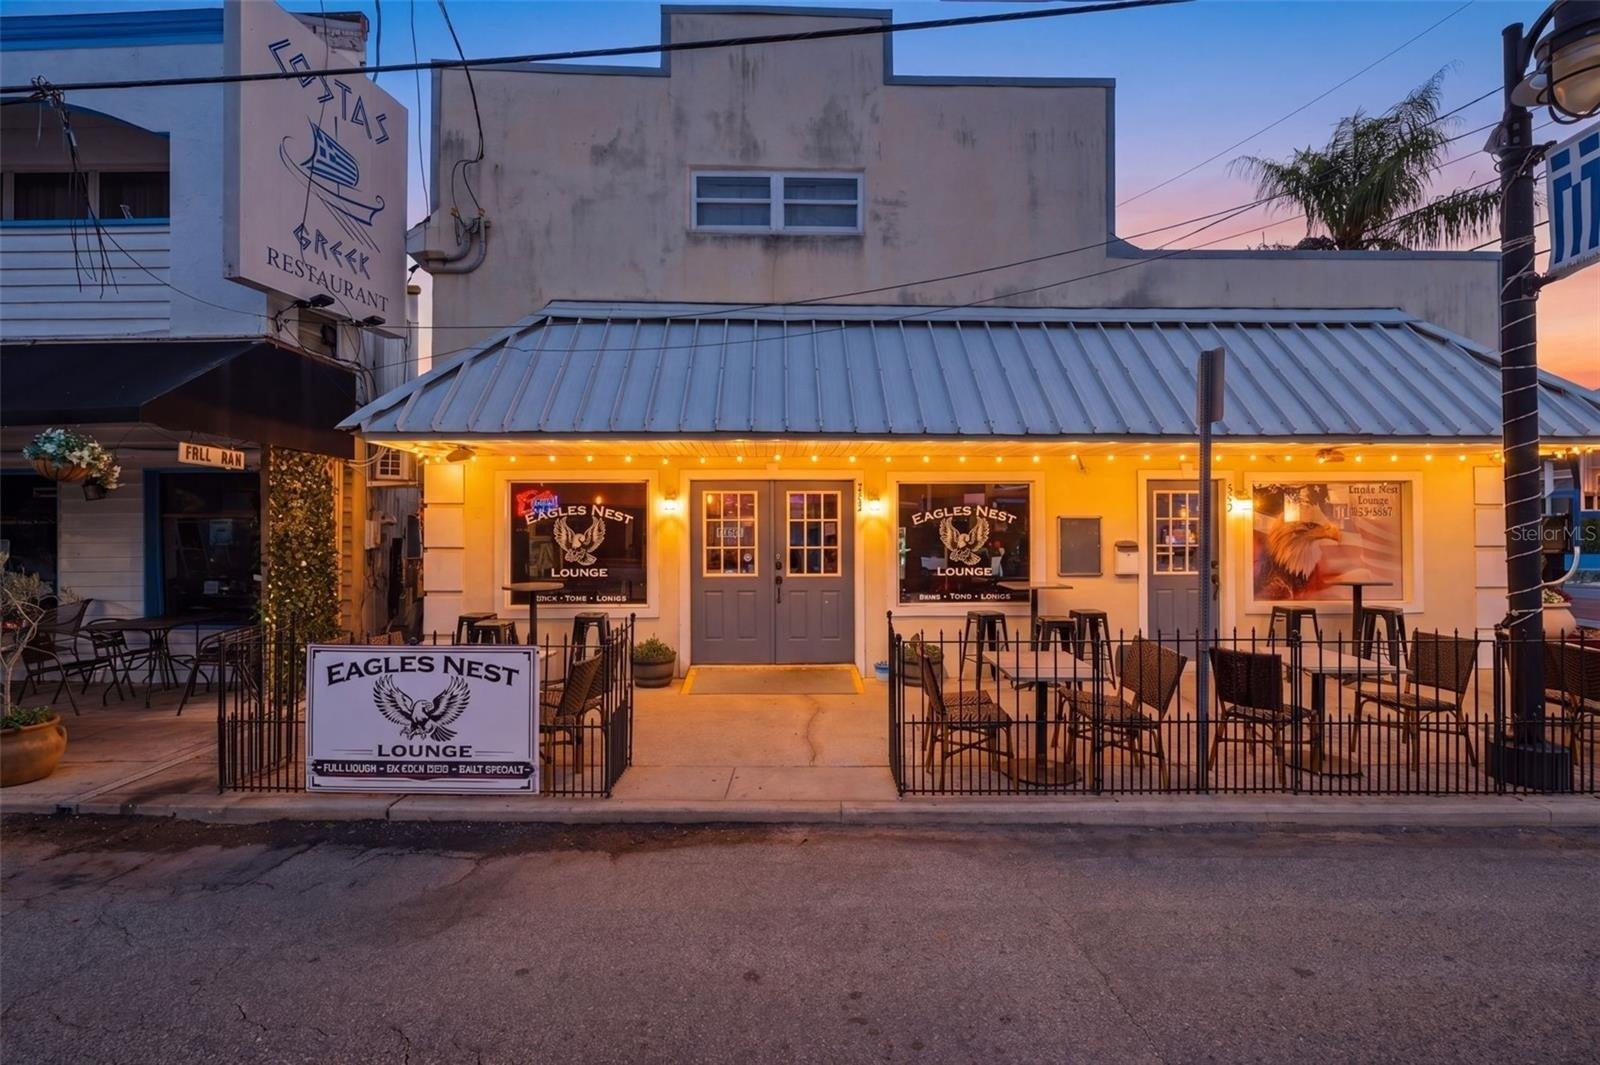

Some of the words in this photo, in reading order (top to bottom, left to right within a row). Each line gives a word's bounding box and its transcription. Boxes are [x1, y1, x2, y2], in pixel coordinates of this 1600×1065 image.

[293, 223, 371, 280] GREEK
[266, 246, 389, 312] RESTAURANT
[525, 506, 587, 525] EAGLES
[591, 504, 634, 524] NEST
[911, 506, 972, 525] EAGLES
[976, 504, 1017, 524] NEST
[551, 568, 608, 578] LOUNGE
[937, 567, 993, 576] LOUNGE
[326, 655, 435, 687] EAGLES
[443, 655, 520, 687] NEST
[377, 744, 472, 758] LOUNGE
[323, 763, 344, 773] FULL
